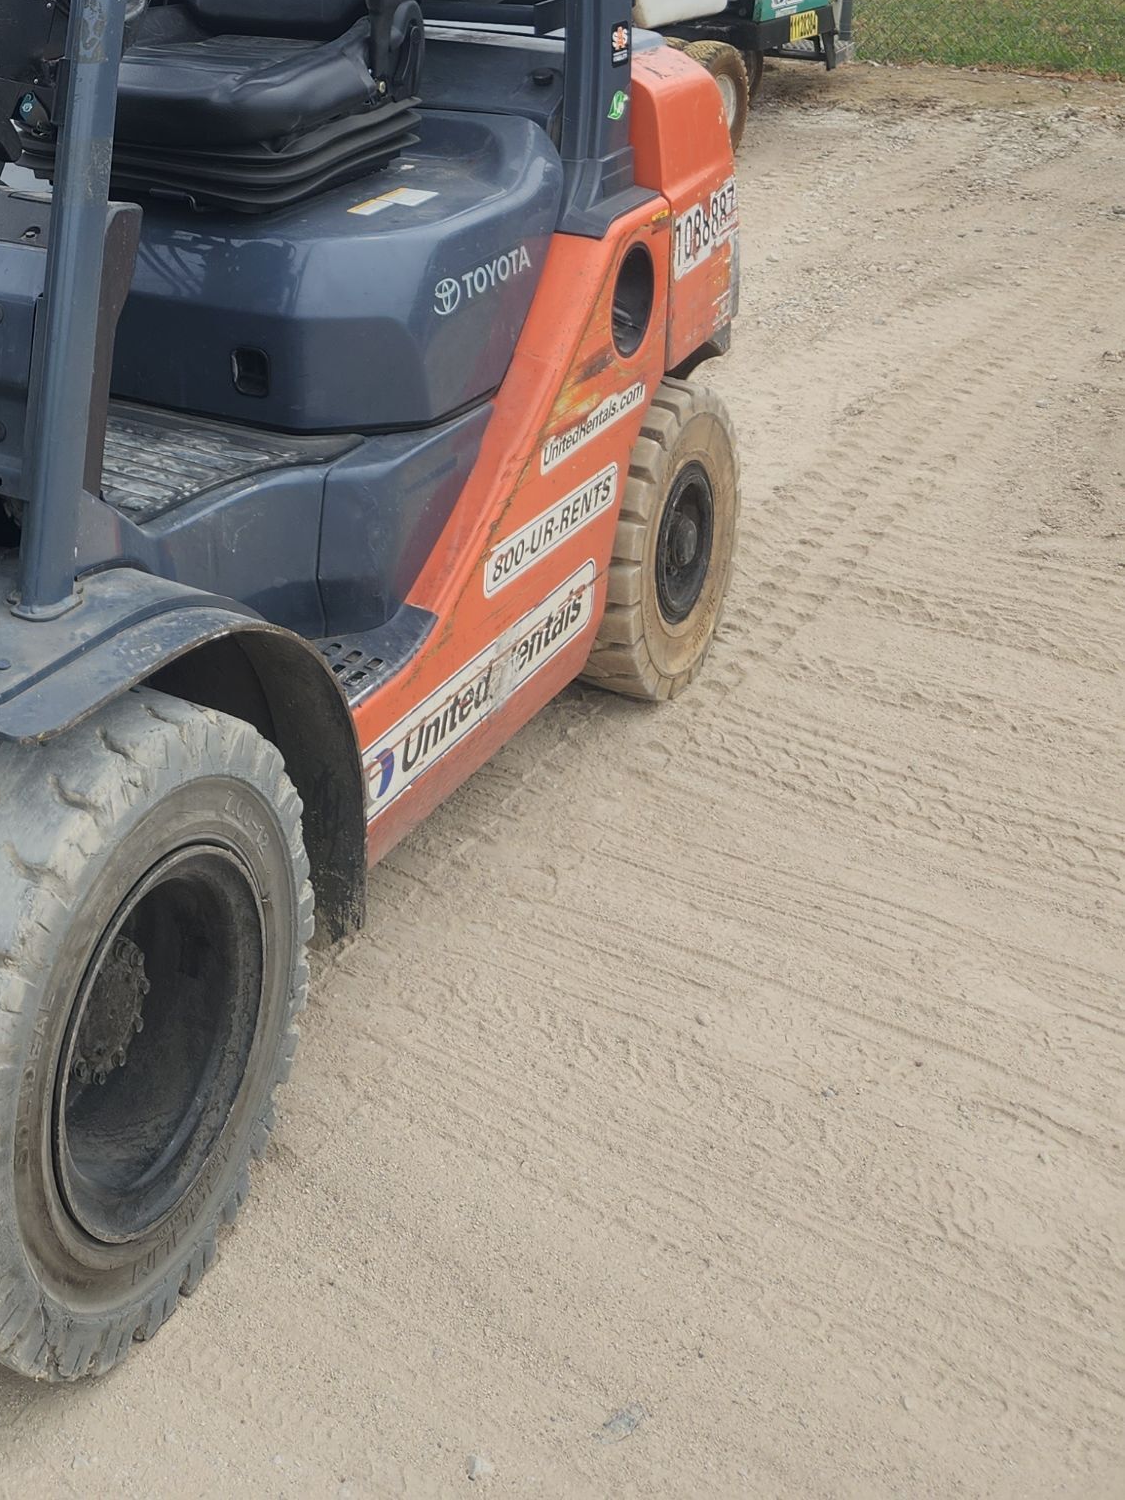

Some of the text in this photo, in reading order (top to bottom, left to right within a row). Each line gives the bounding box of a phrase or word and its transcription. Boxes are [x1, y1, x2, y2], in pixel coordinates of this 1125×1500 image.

[461, 245, 532, 299] TOYOTA
[543, 384, 644, 467] UnitedRentals.com
[492, 474, 612, 583] 800-UR-RENTS
[401, 659, 494, 773] United
